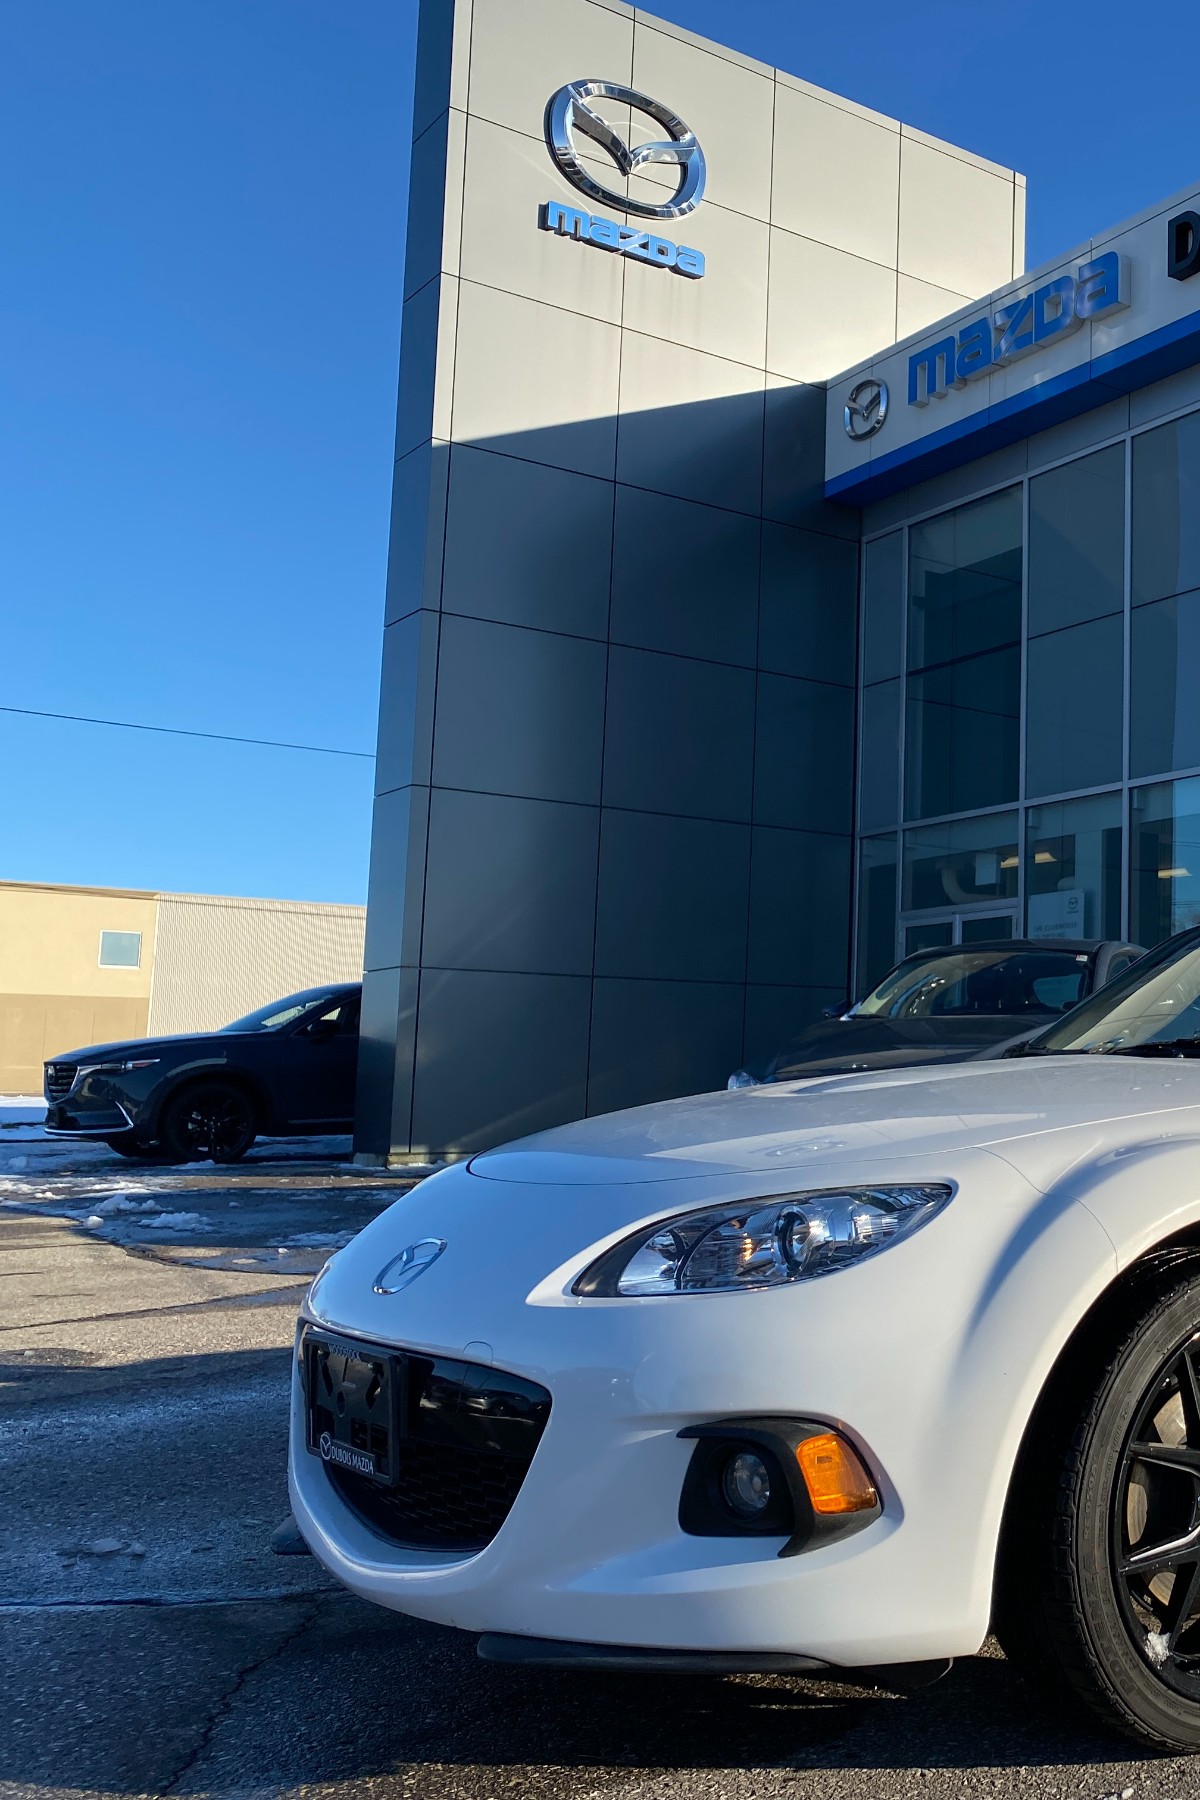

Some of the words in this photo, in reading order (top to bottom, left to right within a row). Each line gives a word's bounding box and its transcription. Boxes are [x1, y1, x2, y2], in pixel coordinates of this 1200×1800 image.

[538, 200, 706, 279] mazda
[908, 251, 1131, 408] mazda
[331, 1446, 352, 1466] DUBOIS
[352, 1453, 374, 1475] MAZDA
